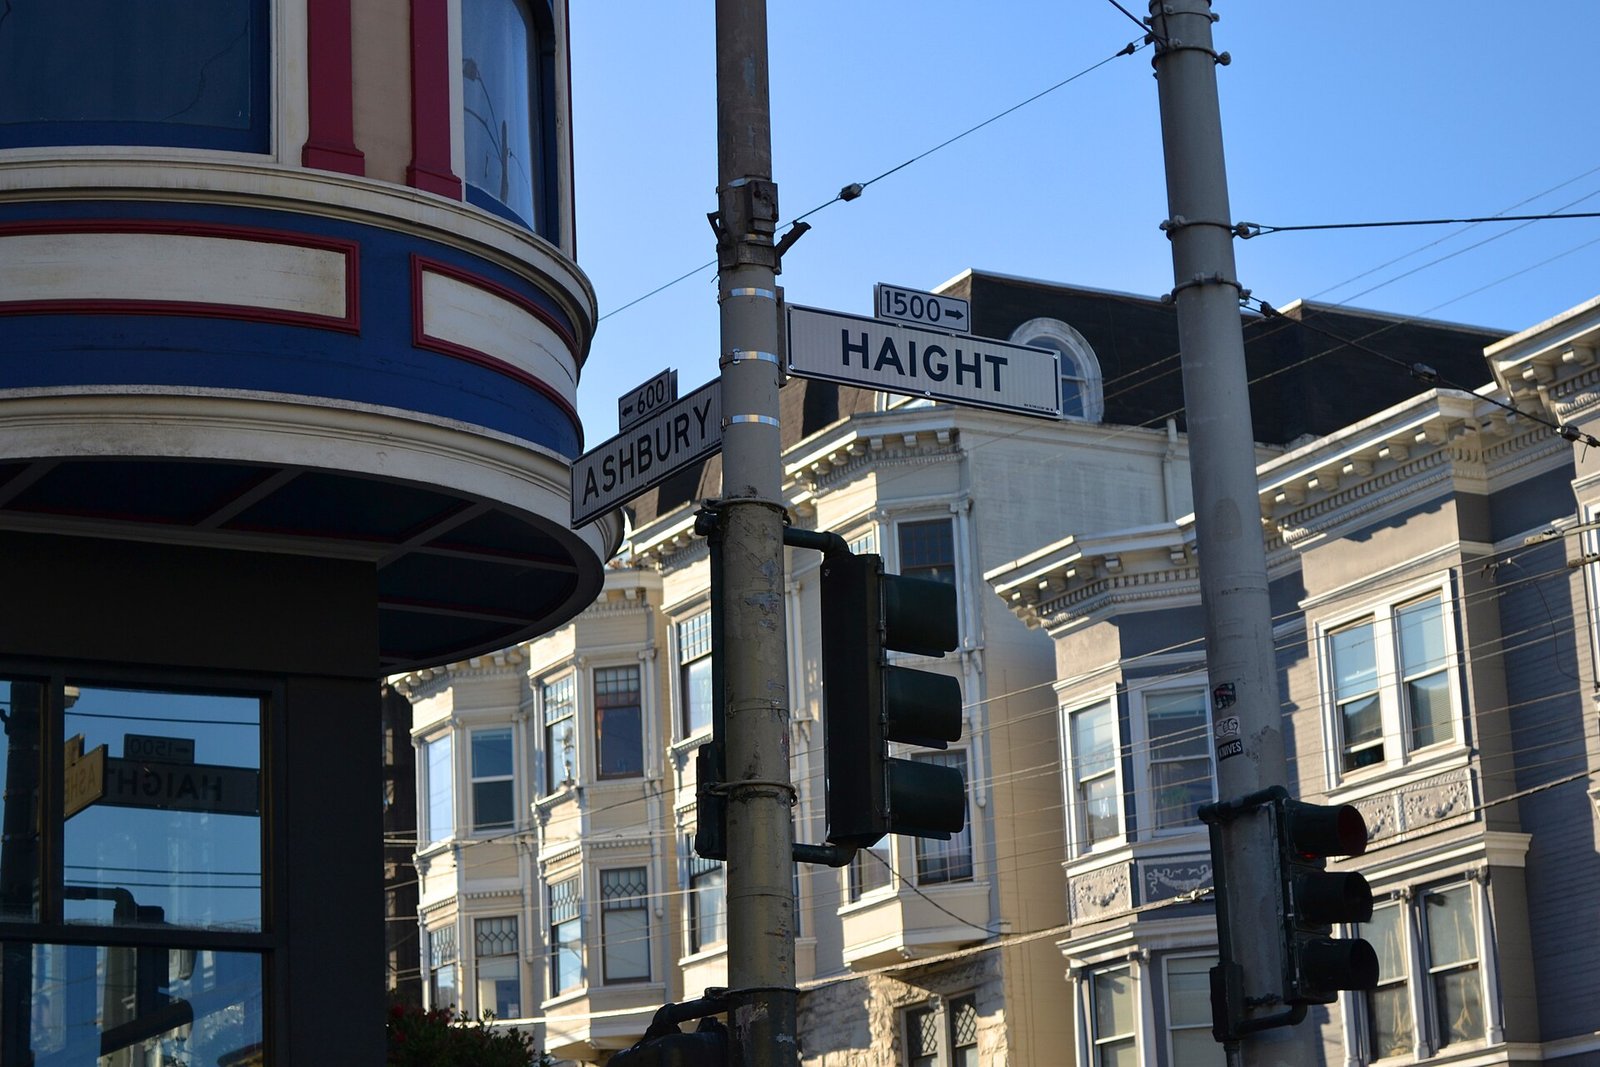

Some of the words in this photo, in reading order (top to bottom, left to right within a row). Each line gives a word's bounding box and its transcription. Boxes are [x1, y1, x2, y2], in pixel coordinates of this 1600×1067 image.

[884, 290, 941, 322] 1500
[841, 329, 1008, 392] HAIGHT
[637, 379, 664, 415] 600
[582, 398, 712, 506] ASHBURY
